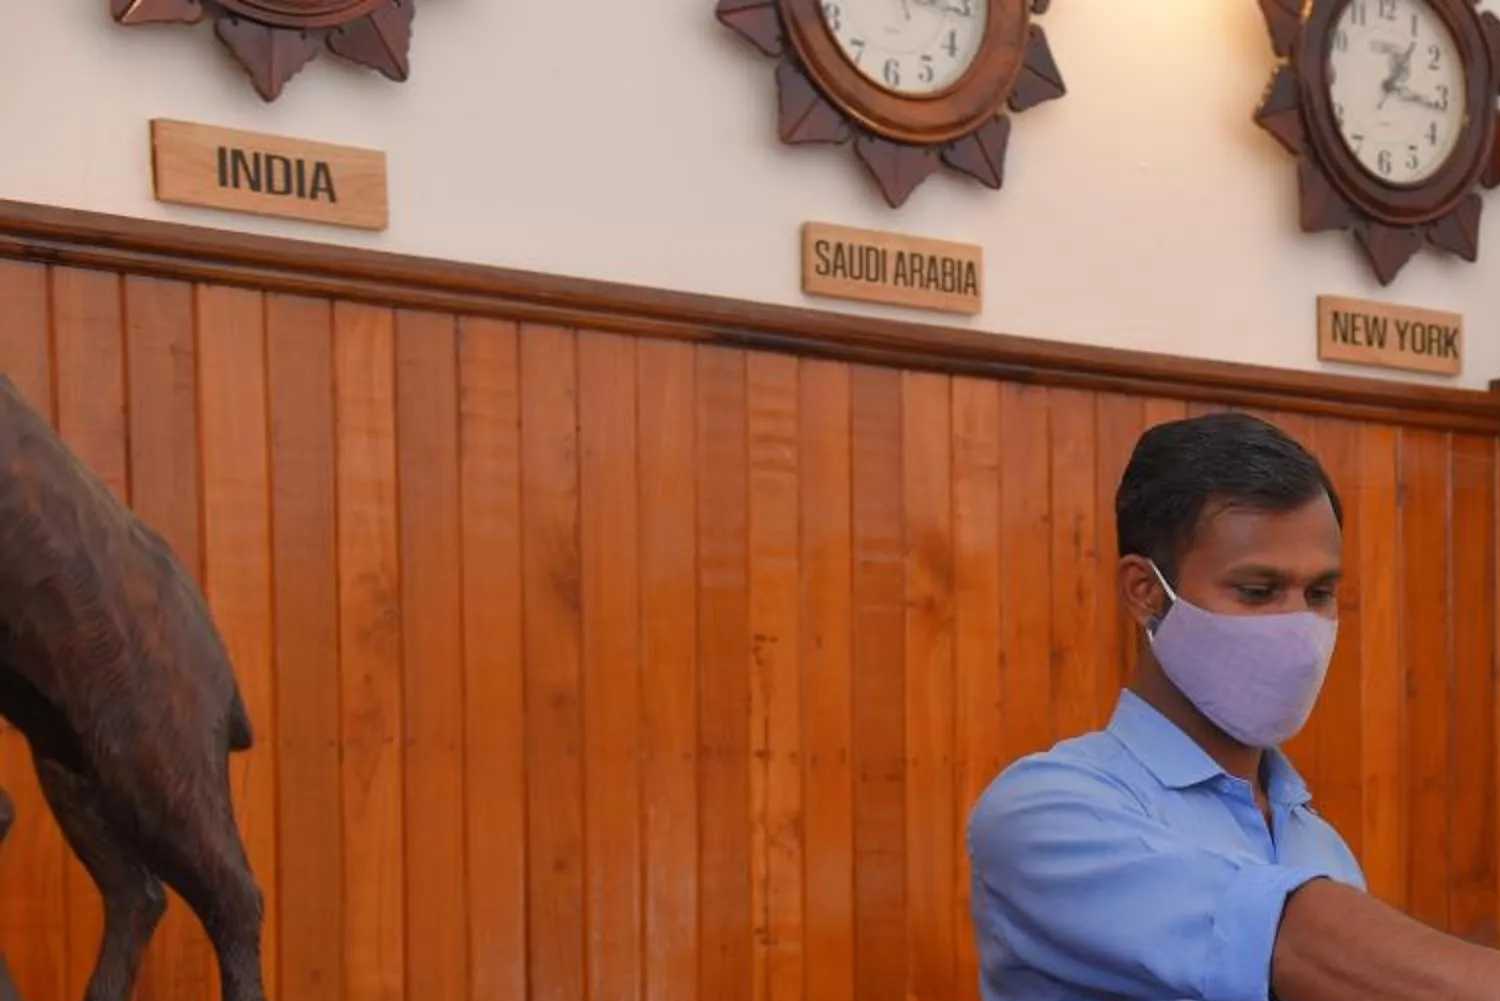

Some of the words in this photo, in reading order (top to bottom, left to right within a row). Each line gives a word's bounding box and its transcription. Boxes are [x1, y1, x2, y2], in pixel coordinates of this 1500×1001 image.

[850, 37, 865, 66] 7
[941, 29, 959, 58] 4
[1428, 44, 1440, 71] 2
[884, 58, 900, 87] 6
[918, 54, 934, 83] 5
[1424, 120, 1436, 145] 4
[1377, 150, 1391, 175] 6
[1405, 144, 1418, 170] 5
[216, 146, 337, 204] INDIA
[815, 239, 887, 285] SAUDI
[894, 249, 978, 297] ARABIA
[1331, 310, 1388, 350] NEW
[1394, 318, 1460, 360] YORK
